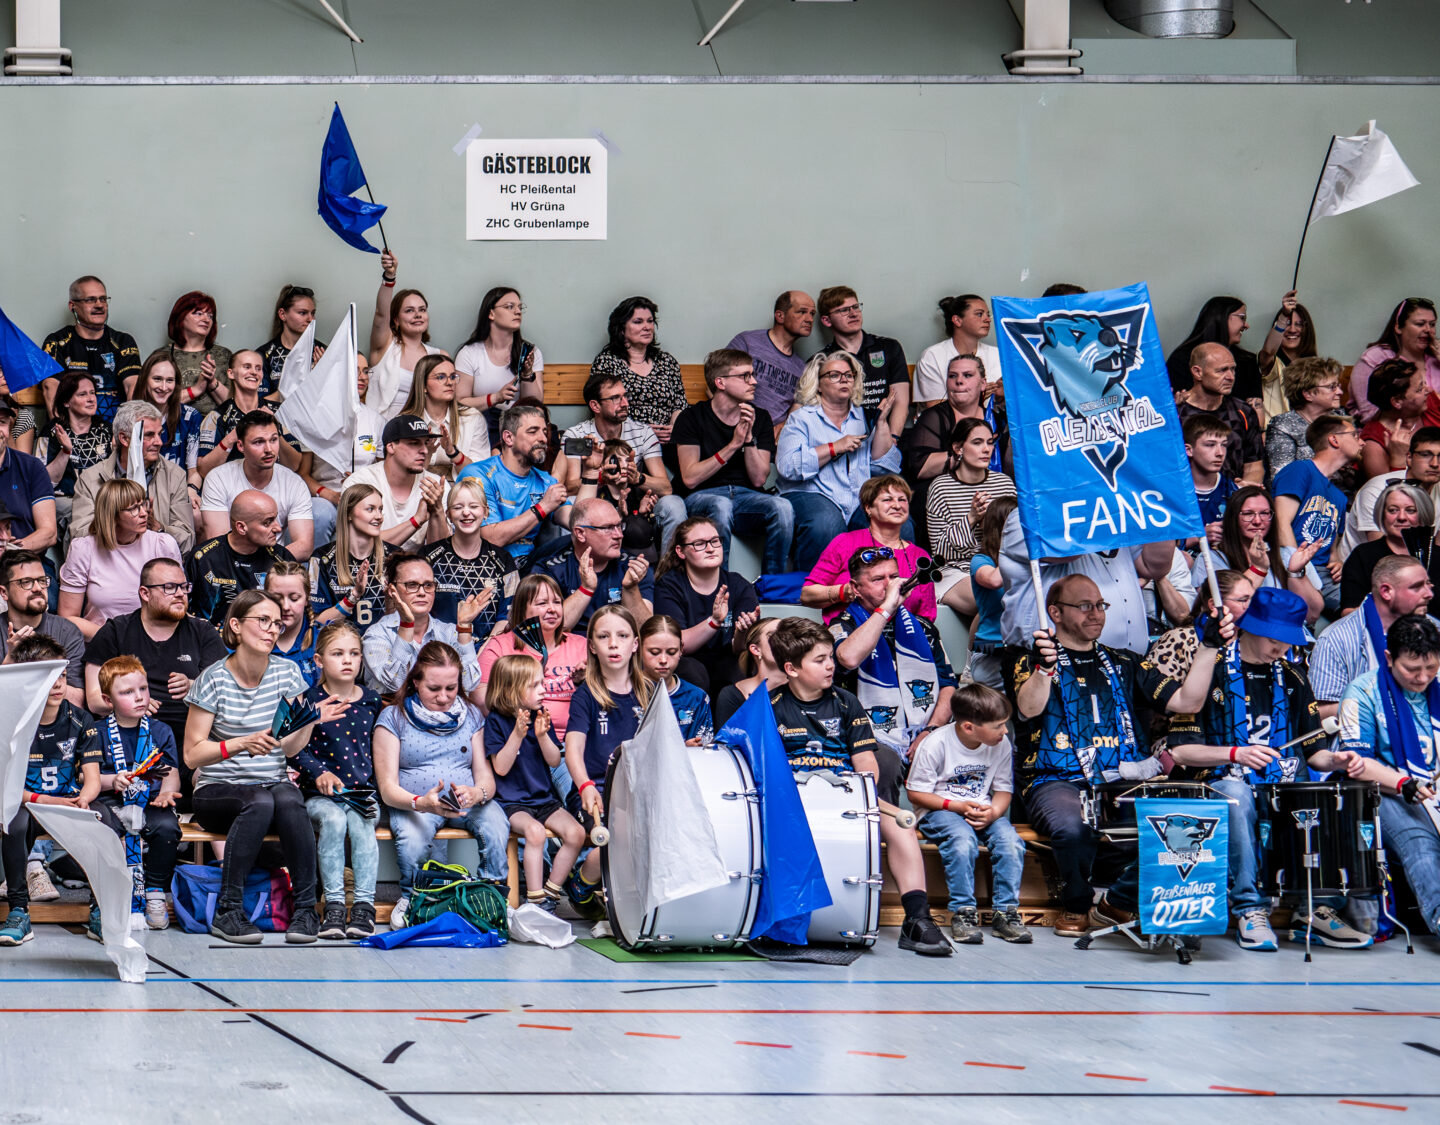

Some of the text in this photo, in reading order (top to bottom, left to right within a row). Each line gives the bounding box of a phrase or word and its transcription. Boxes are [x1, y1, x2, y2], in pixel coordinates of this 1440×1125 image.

[482, 153, 591, 174] GÄSTEBLOCK
[500, 184, 576, 194] HC Pleißental
[511, 201, 565, 211] HV Grüna
[486, 218, 590, 230] ZHC Grubenlampe
[1062, 490, 1171, 542] FANS
[357, 600, 372, 624] 6
[600, 722, 608, 735] 11
[41, 766, 59, 791] 5
[1152, 896, 1216, 926] OTTER
